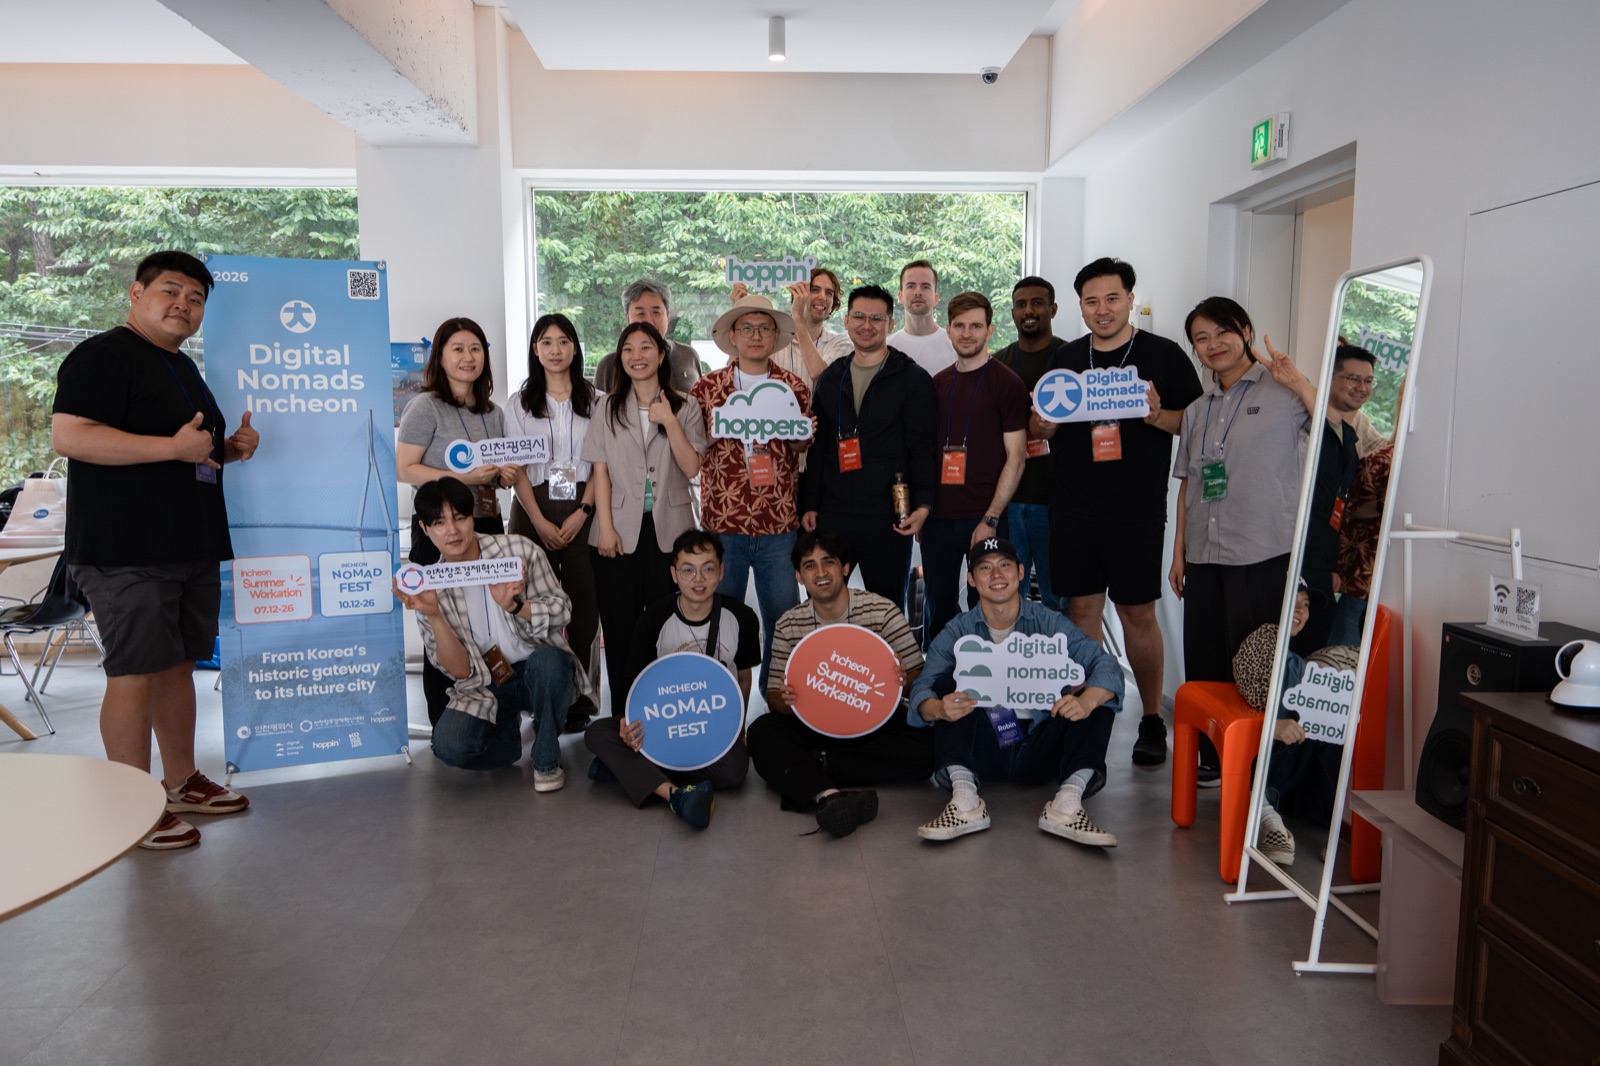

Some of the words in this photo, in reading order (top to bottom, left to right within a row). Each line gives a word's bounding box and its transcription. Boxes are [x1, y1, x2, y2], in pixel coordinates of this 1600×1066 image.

[212, 271, 249, 282] 2026
[728, 258, 814, 288] hoppin'
[250, 342, 350, 370] Digital
[238, 369, 365, 390] Nomads
[1086, 370, 1133, 386] Digital
[1086, 383, 1145, 398] Nomads
[246, 394, 358, 413] Incheon
[1086, 398, 1144, 411] Incheon
[714, 411, 809, 440] hoppers
[480, 438, 544, 456] 인천광역시
[504, 453, 536, 462] Metropolitan
[332, 568, 382, 580] NOMAD
[426, 561, 518, 579] 인천창조경제혁신센터
[243, 578, 286, 589] Summer
[340, 581, 372, 593] FEST
[250, 588, 302, 599] Workation
[254, 604, 294, 614] 07.12-26
[338, 599, 375, 609] 10.12-26
[262, 651, 304, 664] From
[307, 645, 366, 660] Korea's
[1007, 636, 1062, 658] digital
[830, 650, 870, 676] incheon
[1007, 663, 1079, 680] nomads
[249, 666, 309, 683] historic
[312, 662, 380, 681] gateway
[816, 662, 872, 695] Summer
[255, 689, 272, 700] to
[275, 686, 294, 699] its
[297, 683, 344, 696] future
[347, 679, 376, 694] city
[658, 680, 707, 696] INCHEON
[806, 673, 870, 714] Workation
[1007, 686, 1056, 704] korea
[643, 694, 726, 721] NOMAD
[668, 721, 708, 739] FEST
[997, 722, 1016, 732] Robin
[312, 738, 340, 749] hoppin'
